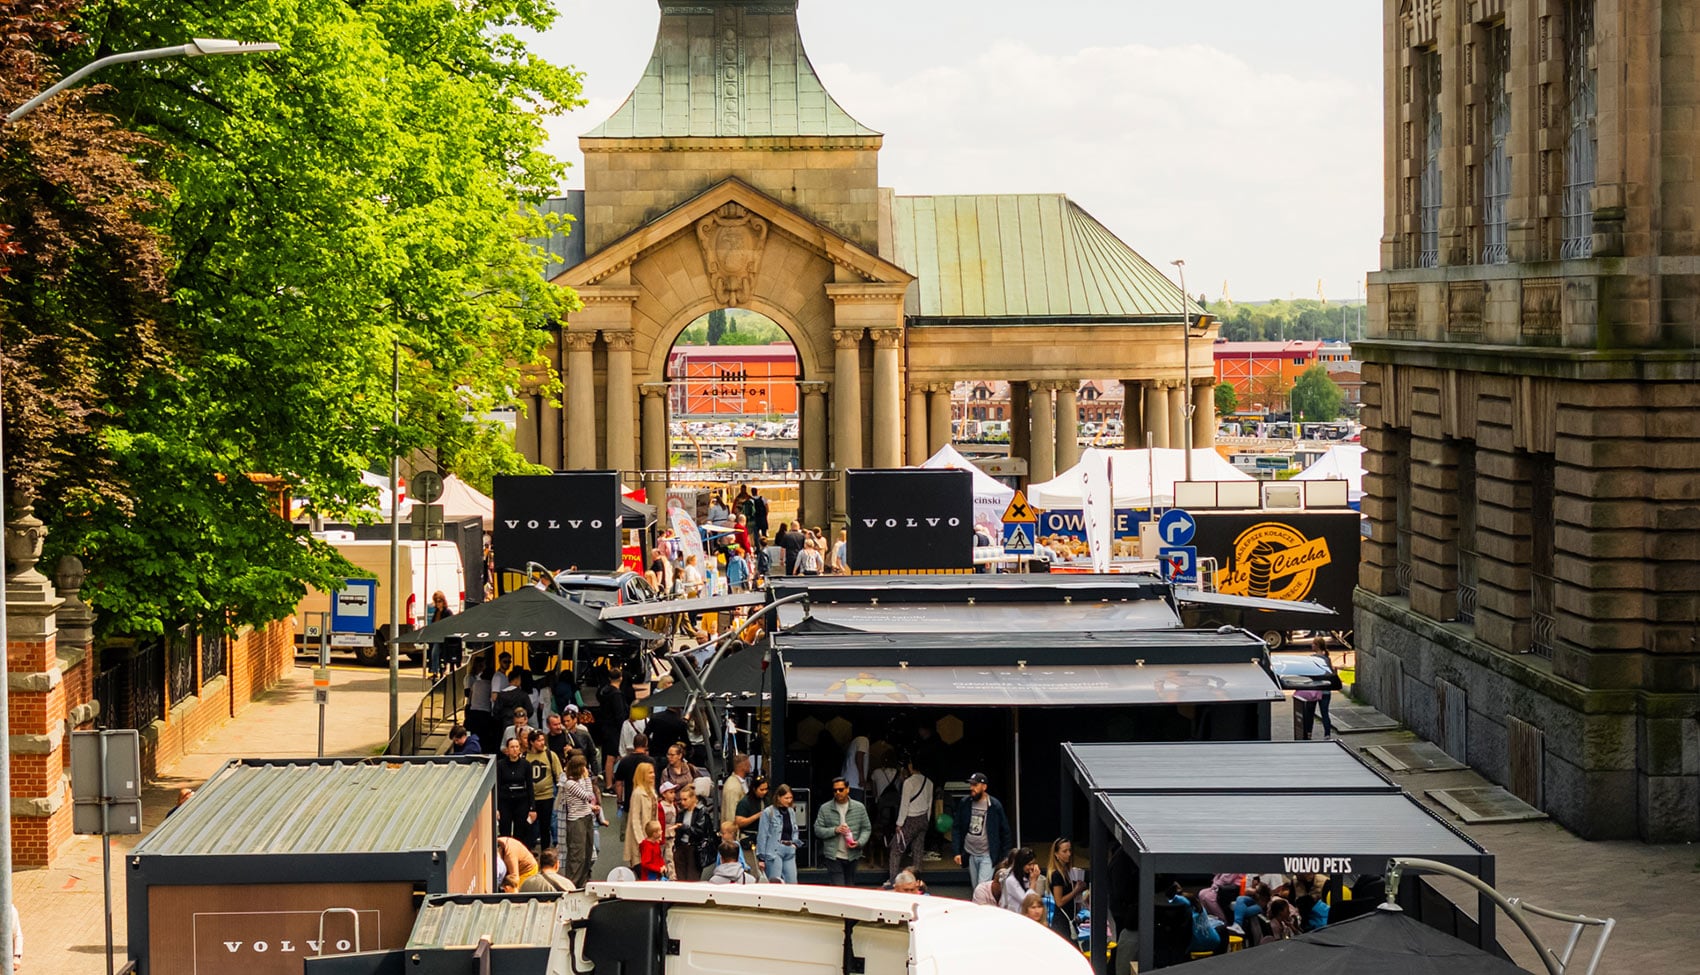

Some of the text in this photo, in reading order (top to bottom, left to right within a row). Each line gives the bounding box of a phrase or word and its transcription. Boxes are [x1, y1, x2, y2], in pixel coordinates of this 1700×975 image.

[504, 519, 604, 530] VOLVO
[862, 516, 961, 528] VOLVO
[1048, 514, 1129, 532] OWE
[1236, 530, 1295, 562] NAJLEPSZE KOŁACZE
[1272, 546, 1327, 574] Ciacha
[309, 627, 318, 635] 90
[453, 630, 558, 639] VOLVO
[1284, 857, 1352, 873] VOLVO PETS
[223, 940, 352, 953] VOLVO
